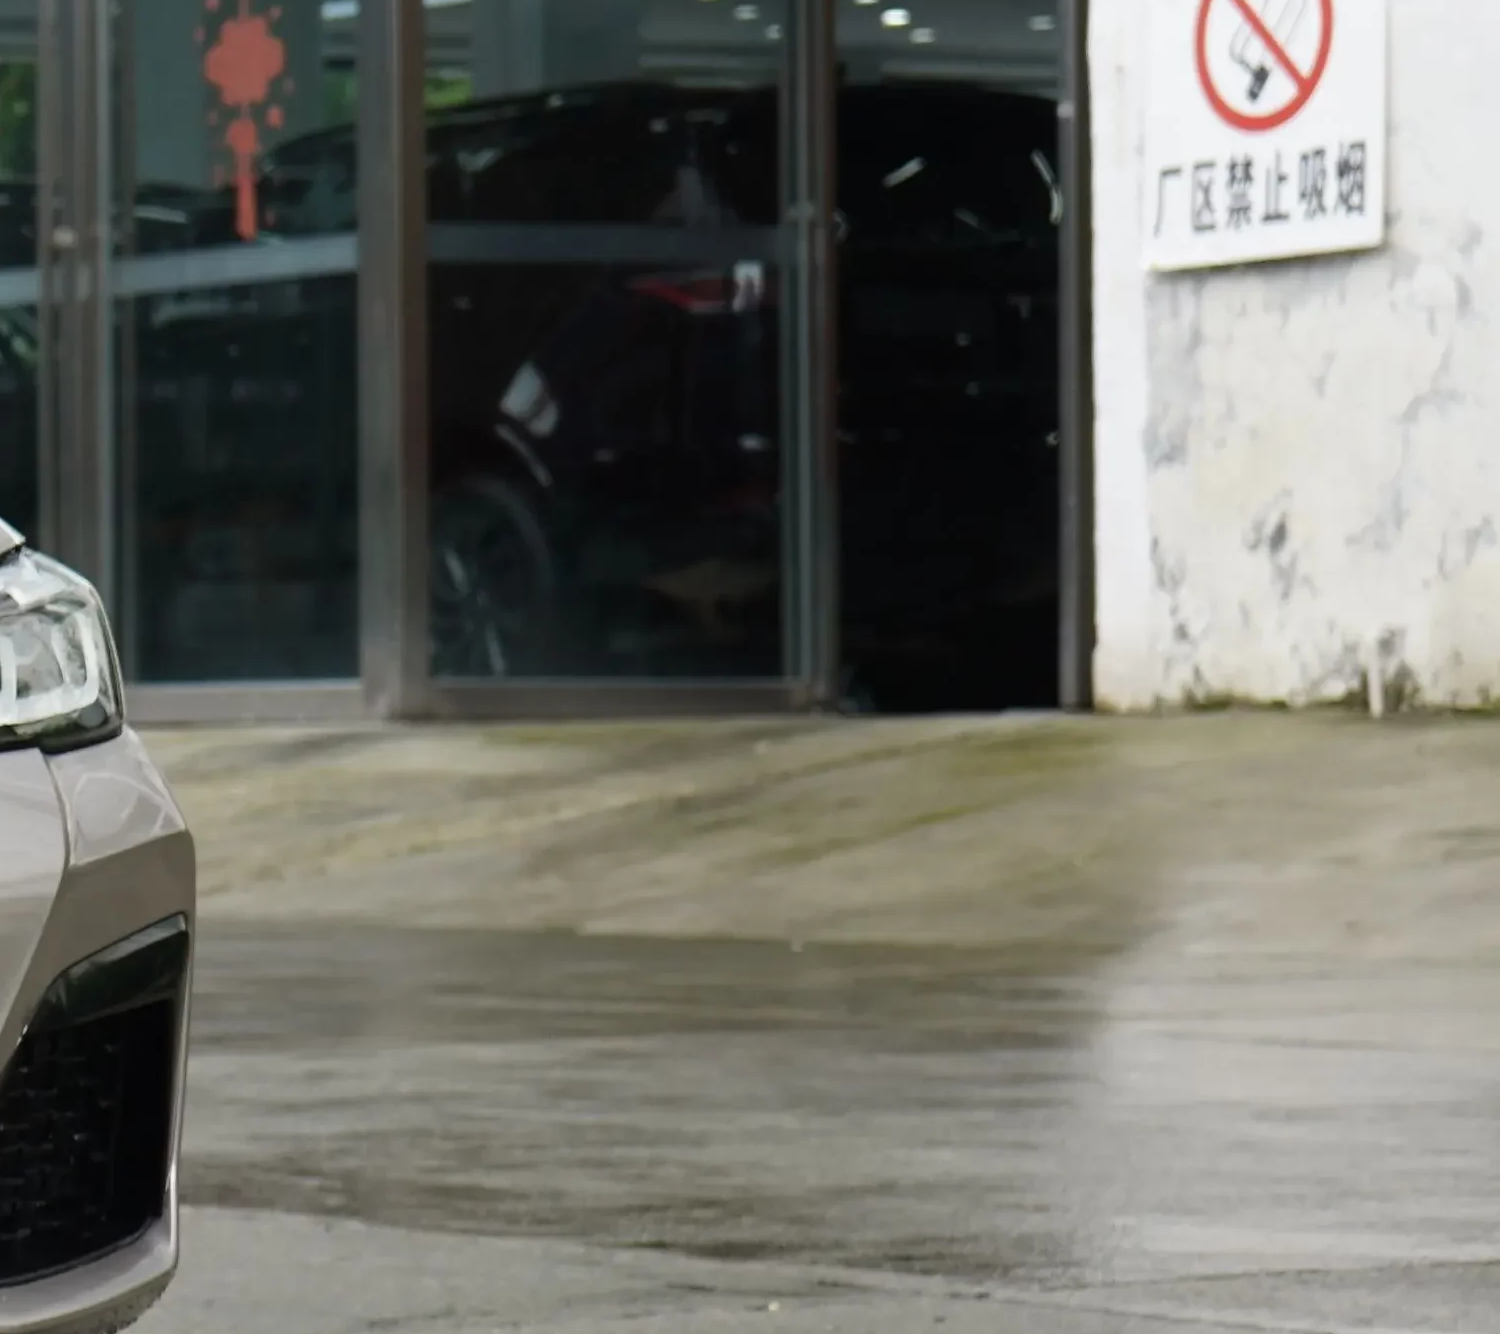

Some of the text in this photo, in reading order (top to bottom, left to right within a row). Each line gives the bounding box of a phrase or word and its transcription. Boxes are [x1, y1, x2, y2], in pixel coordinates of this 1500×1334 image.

[1152, 139, 1368, 240] 厂区禁止吸烟
